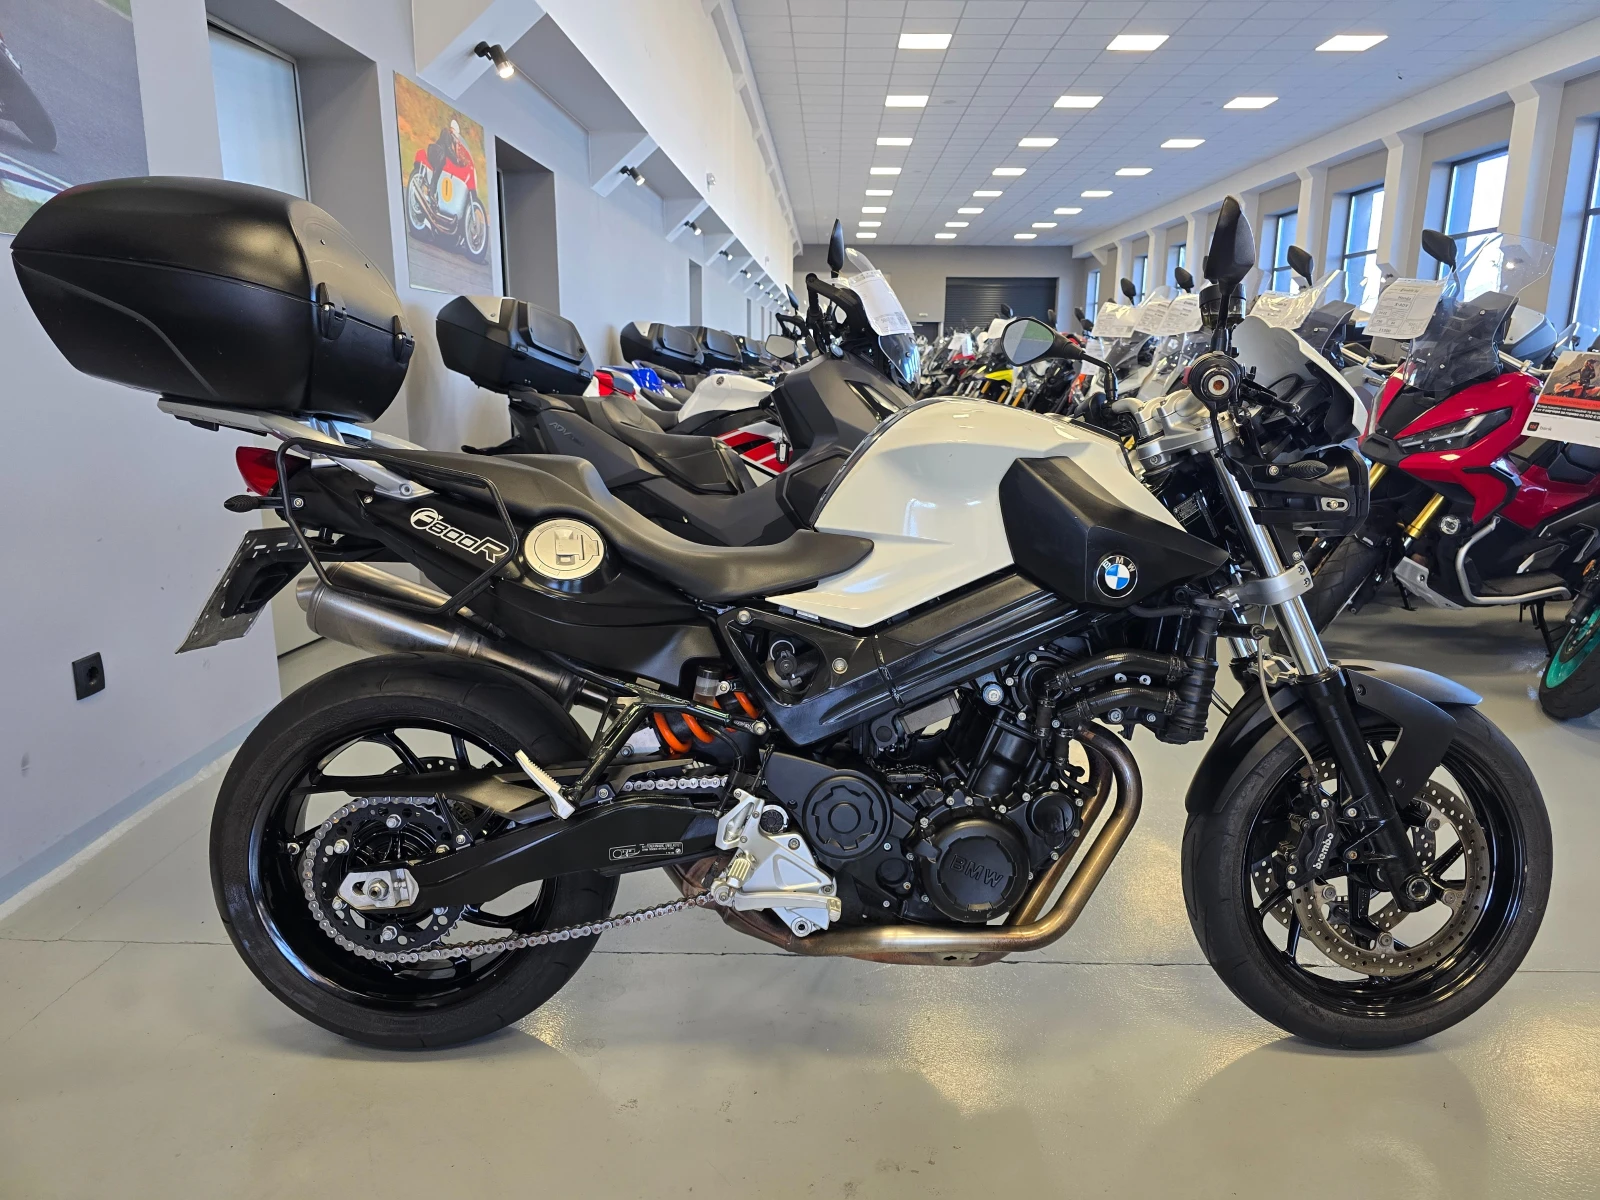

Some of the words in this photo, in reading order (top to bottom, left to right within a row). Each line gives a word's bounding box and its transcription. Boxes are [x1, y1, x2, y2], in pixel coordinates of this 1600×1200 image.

[1102, 556, 1136, 572] BMW
[1312, 832, 1334, 870] brembo
[950, 853, 1004, 888] BMW
